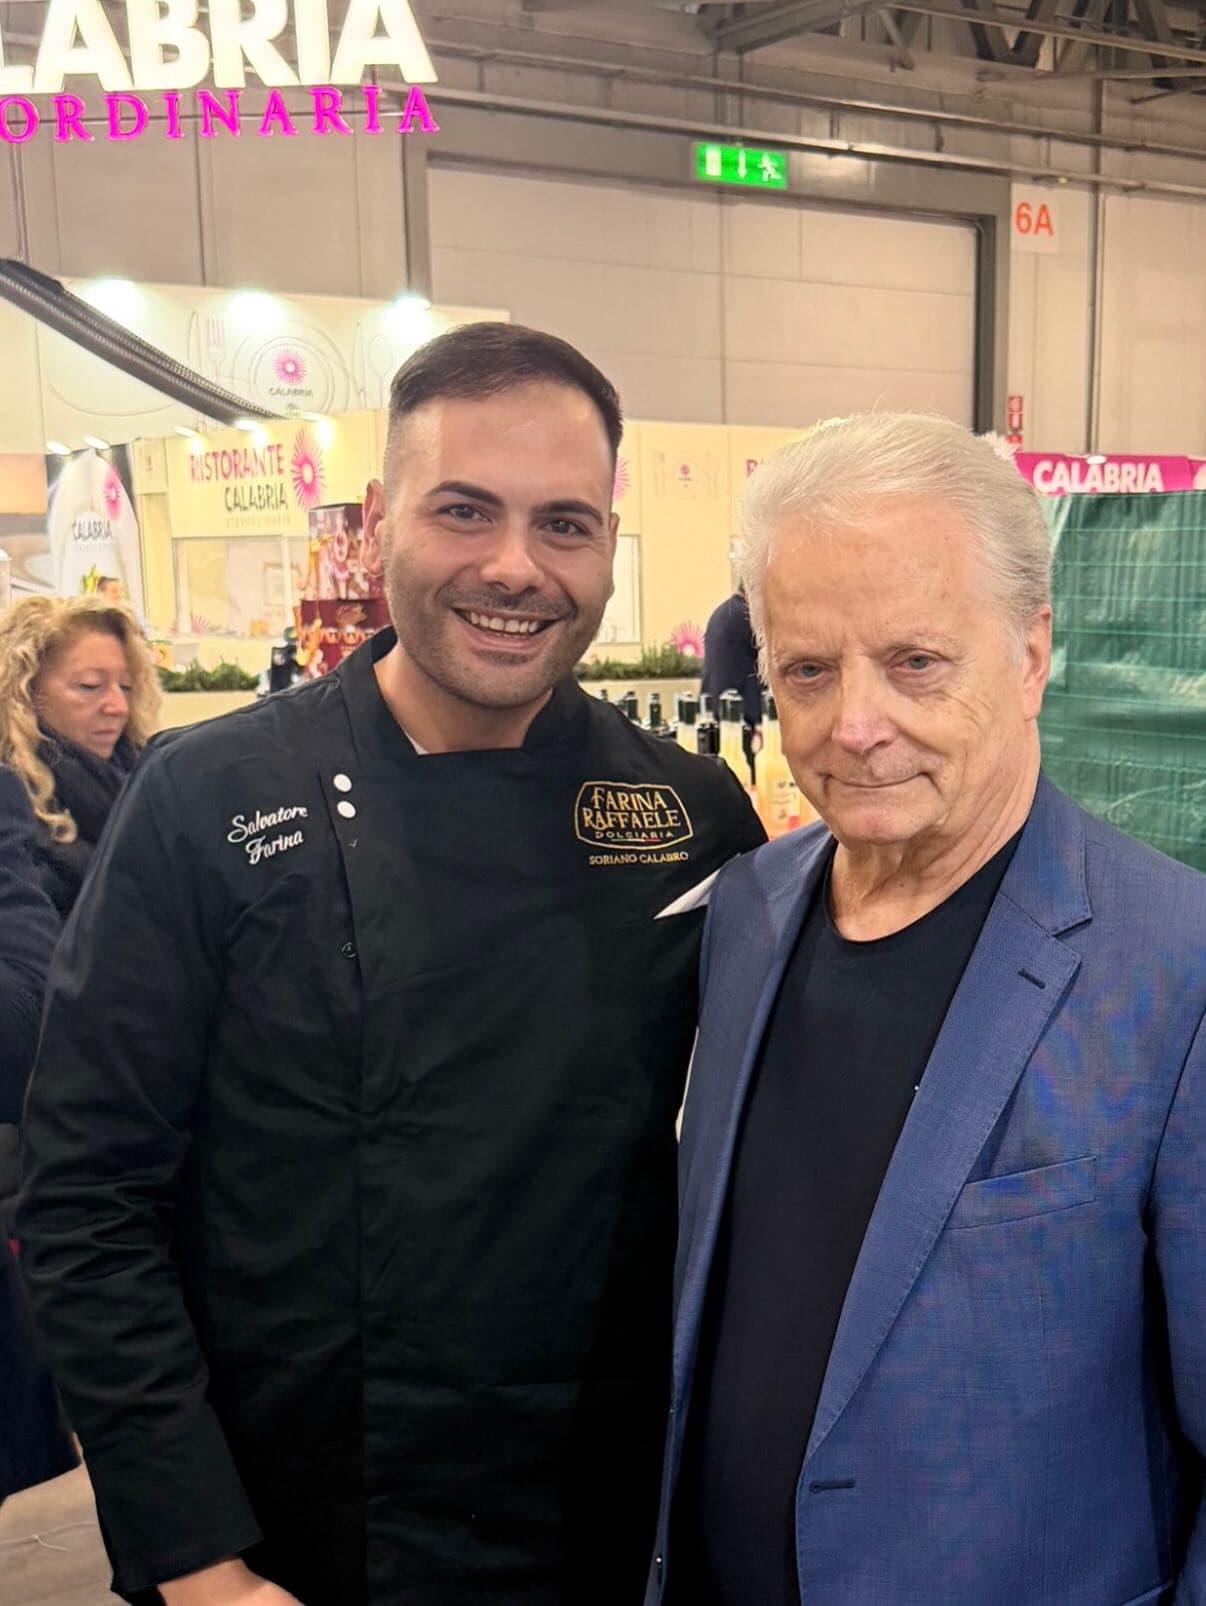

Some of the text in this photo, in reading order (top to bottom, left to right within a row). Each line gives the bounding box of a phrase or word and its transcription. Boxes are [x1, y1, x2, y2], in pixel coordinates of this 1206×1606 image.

[0, 86, 440, 143] ORDINARIA
[1015, 202, 1054, 236] 6A
[190, 444, 284, 481] RISTORANTE
[1033, 460, 1164, 493] CALABRIA
[225, 483, 288, 512] CALABRIA
[591, 787, 667, 811] FARINA
[227, 806, 308, 842] Salvatore
[582, 807, 681, 830] RAFFAELE
[595, 831, 674, 839] DOLCIARIA
[245, 830, 304, 865] Farina
[589, 851, 689, 865] SORIANO CALABRO
